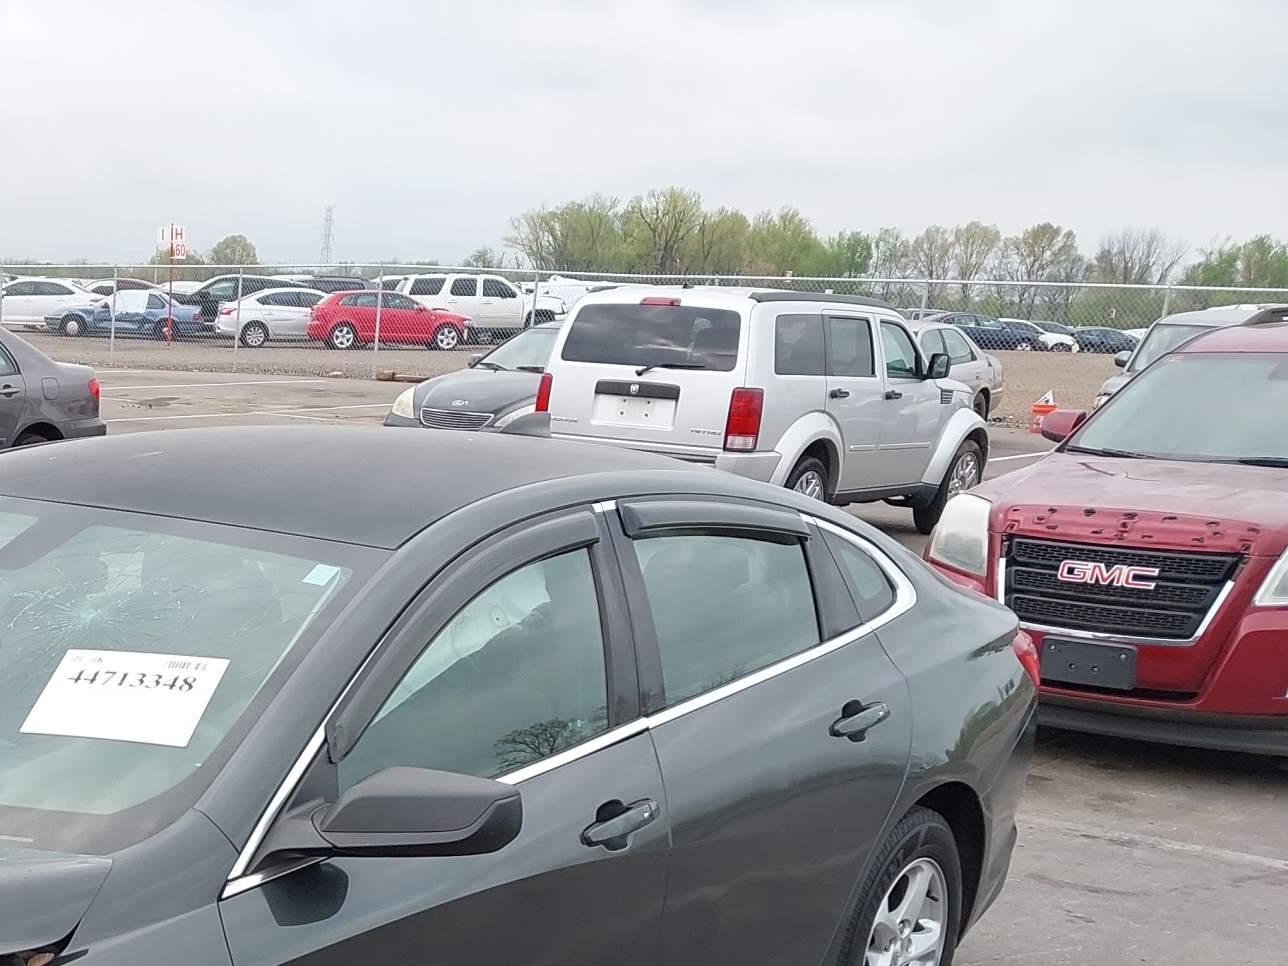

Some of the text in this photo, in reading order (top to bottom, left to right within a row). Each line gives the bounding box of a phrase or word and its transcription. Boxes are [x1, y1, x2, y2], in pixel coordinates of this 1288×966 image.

[175, 227, 183, 241] H
[175, 244, 186, 257] 60
[1057, 560, 1160, 590] GMC
[67, 669, 197, 691] 44713348
